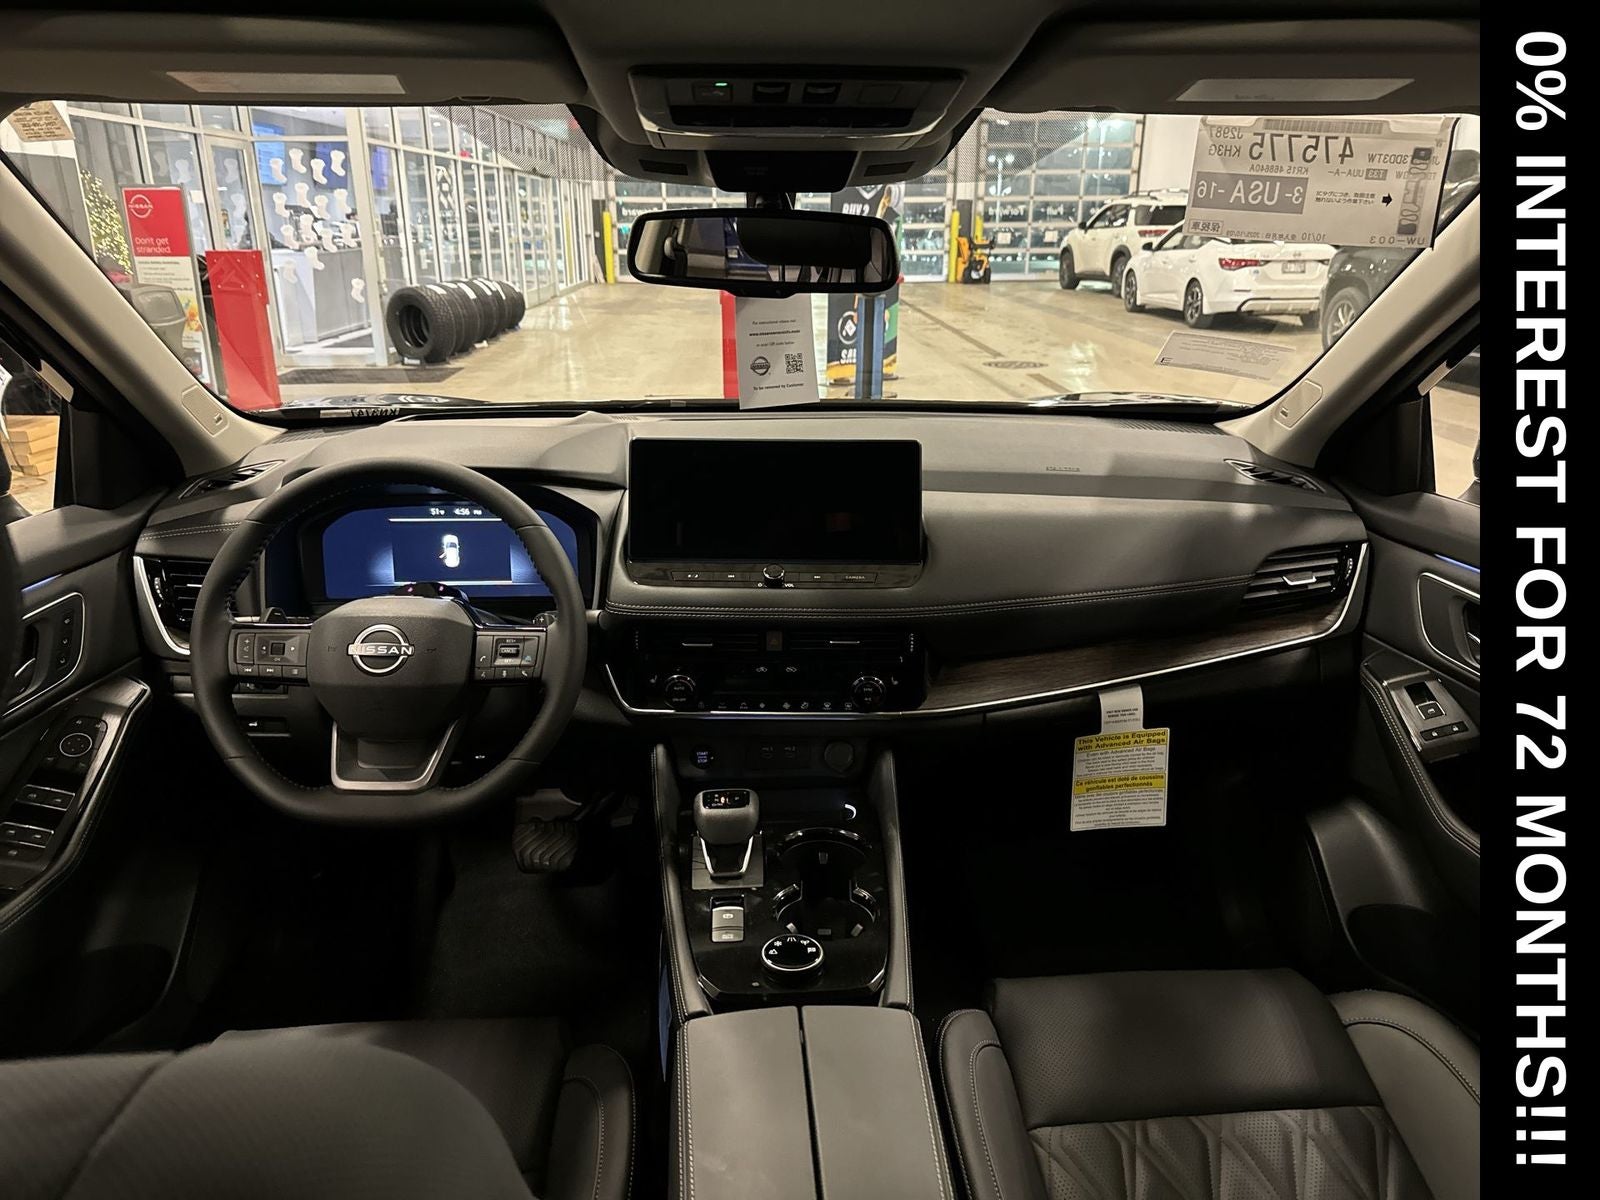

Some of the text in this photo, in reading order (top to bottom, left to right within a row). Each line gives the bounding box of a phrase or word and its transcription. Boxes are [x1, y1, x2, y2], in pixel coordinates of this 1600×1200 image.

[156, 237, 169, 246] get
[349, 644, 414, 656] NISSAN
[1077, 738, 1094, 746] This
[1095, 735, 1122, 743] Vehicle
[1131, 730, 1166, 739] Equipped
[1077, 744, 1095, 752] with
[1095, 740, 1131, 749] Advanced
[1147, 737, 1166, 745] Bags
